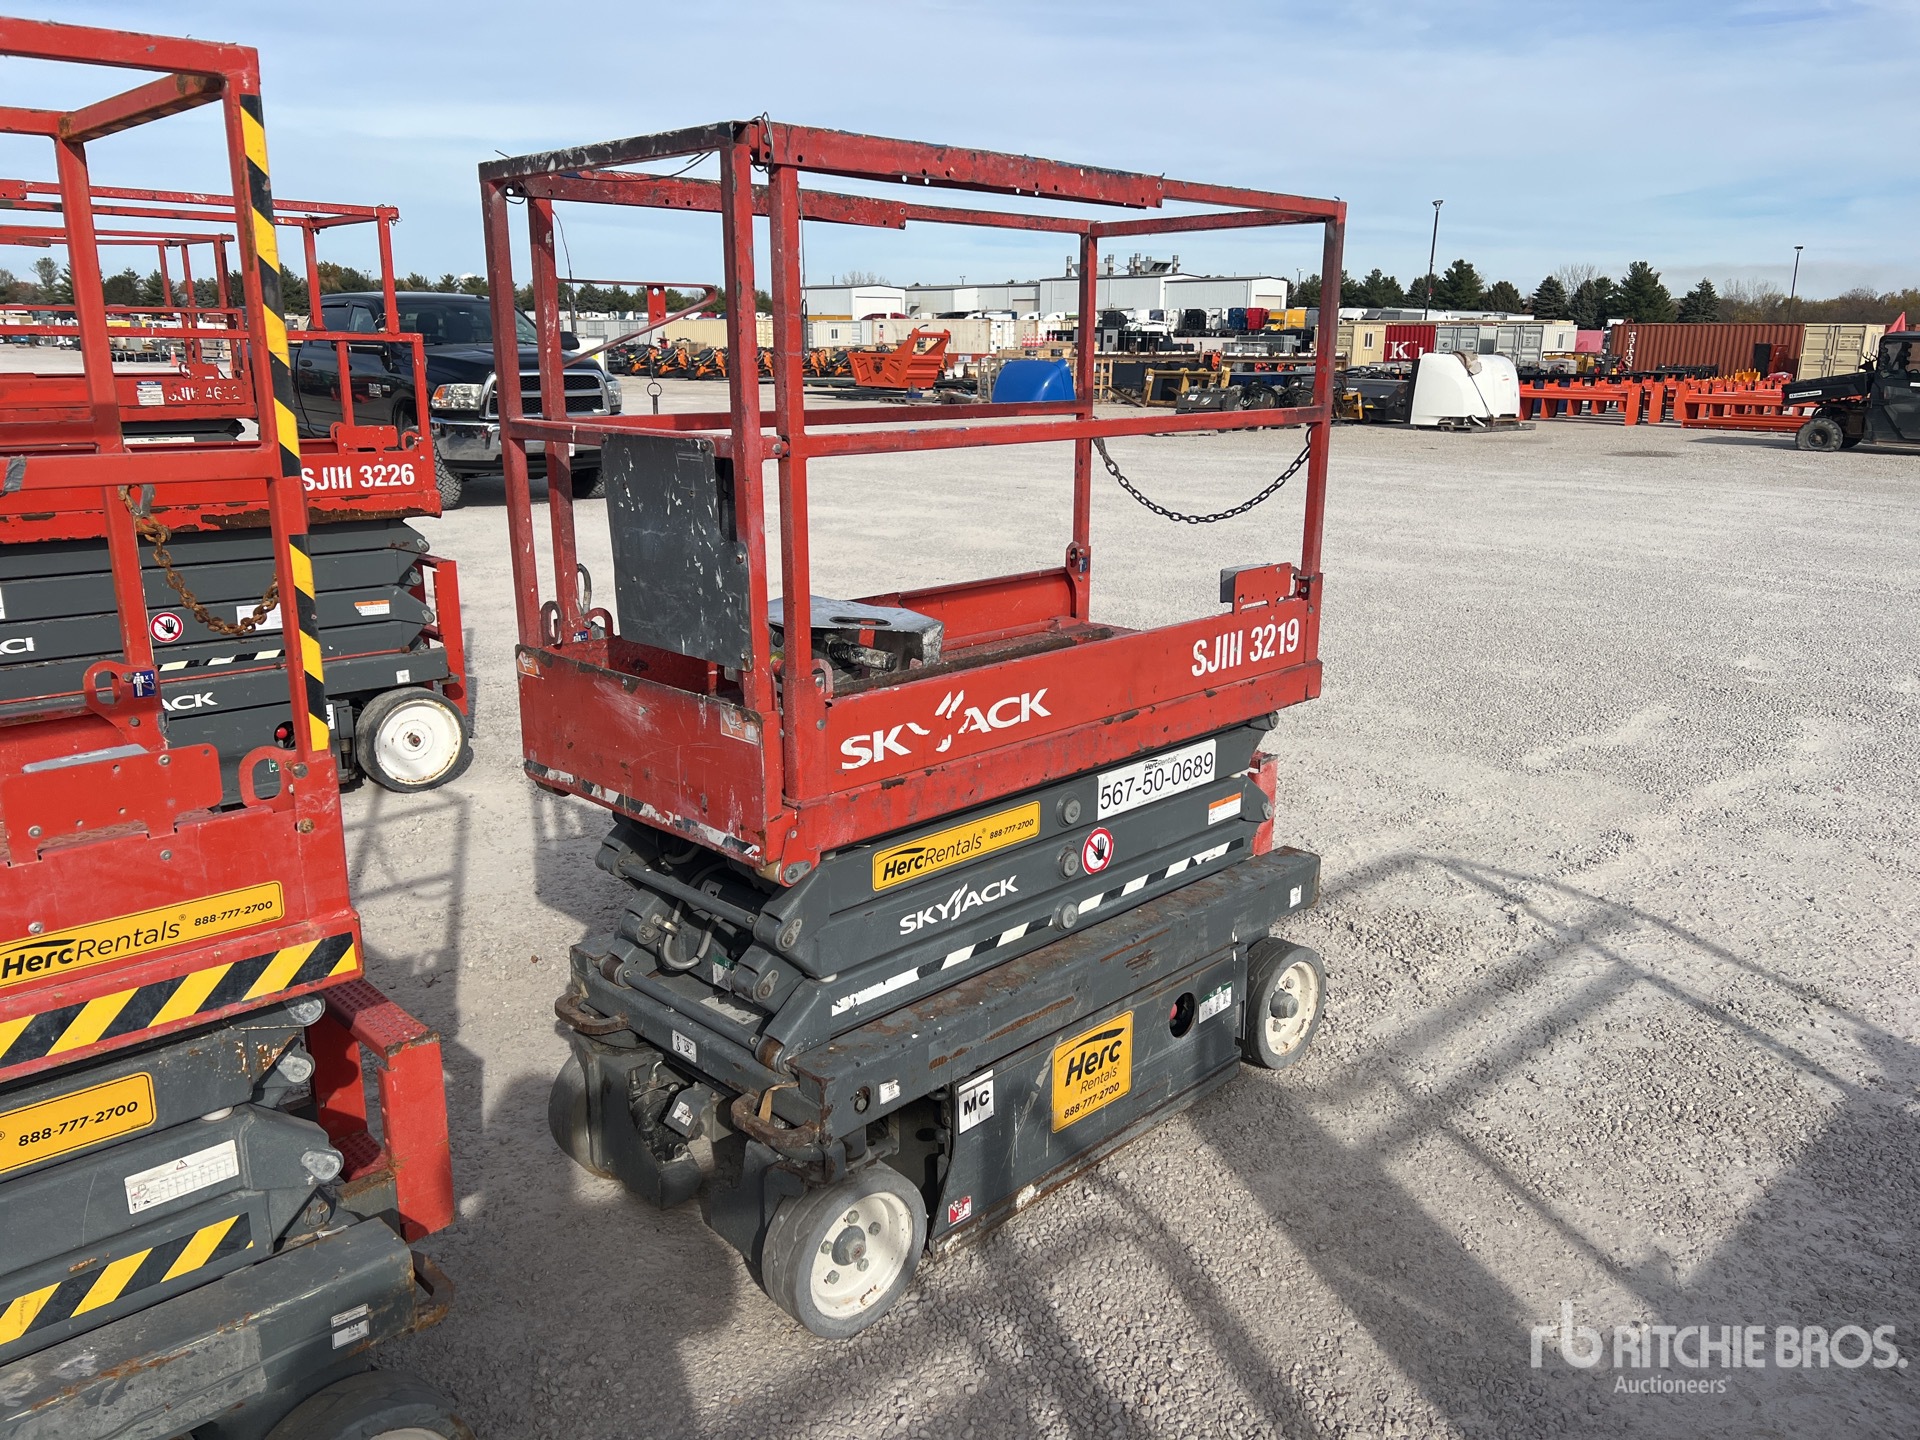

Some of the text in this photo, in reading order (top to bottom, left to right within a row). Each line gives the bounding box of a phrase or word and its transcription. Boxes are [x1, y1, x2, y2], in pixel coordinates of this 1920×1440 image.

[1624, 331, 1637, 367] TRITON
[301, 463, 415, 492] SJIII 3226
[1191, 618, 1300, 677] SJIII 3219
[1100, 751, 1214, 810] 567-50-0689
[1144, 755, 1179, 771] HercRentals
[882, 818, 1034, 881] HercRentals 888-777-2700
[900, 875, 1019, 936] SKYJACK
[1, 900, 273, 980] HercRentals 888-777-2700
[1065, 1040, 1122, 1087] Herc
[1080, 1066, 1118, 1094] Rentals
[1064, 1082, 1120, 1119] 888-777-2700
[18, 1101, 138, 1147] 888-777-2700
